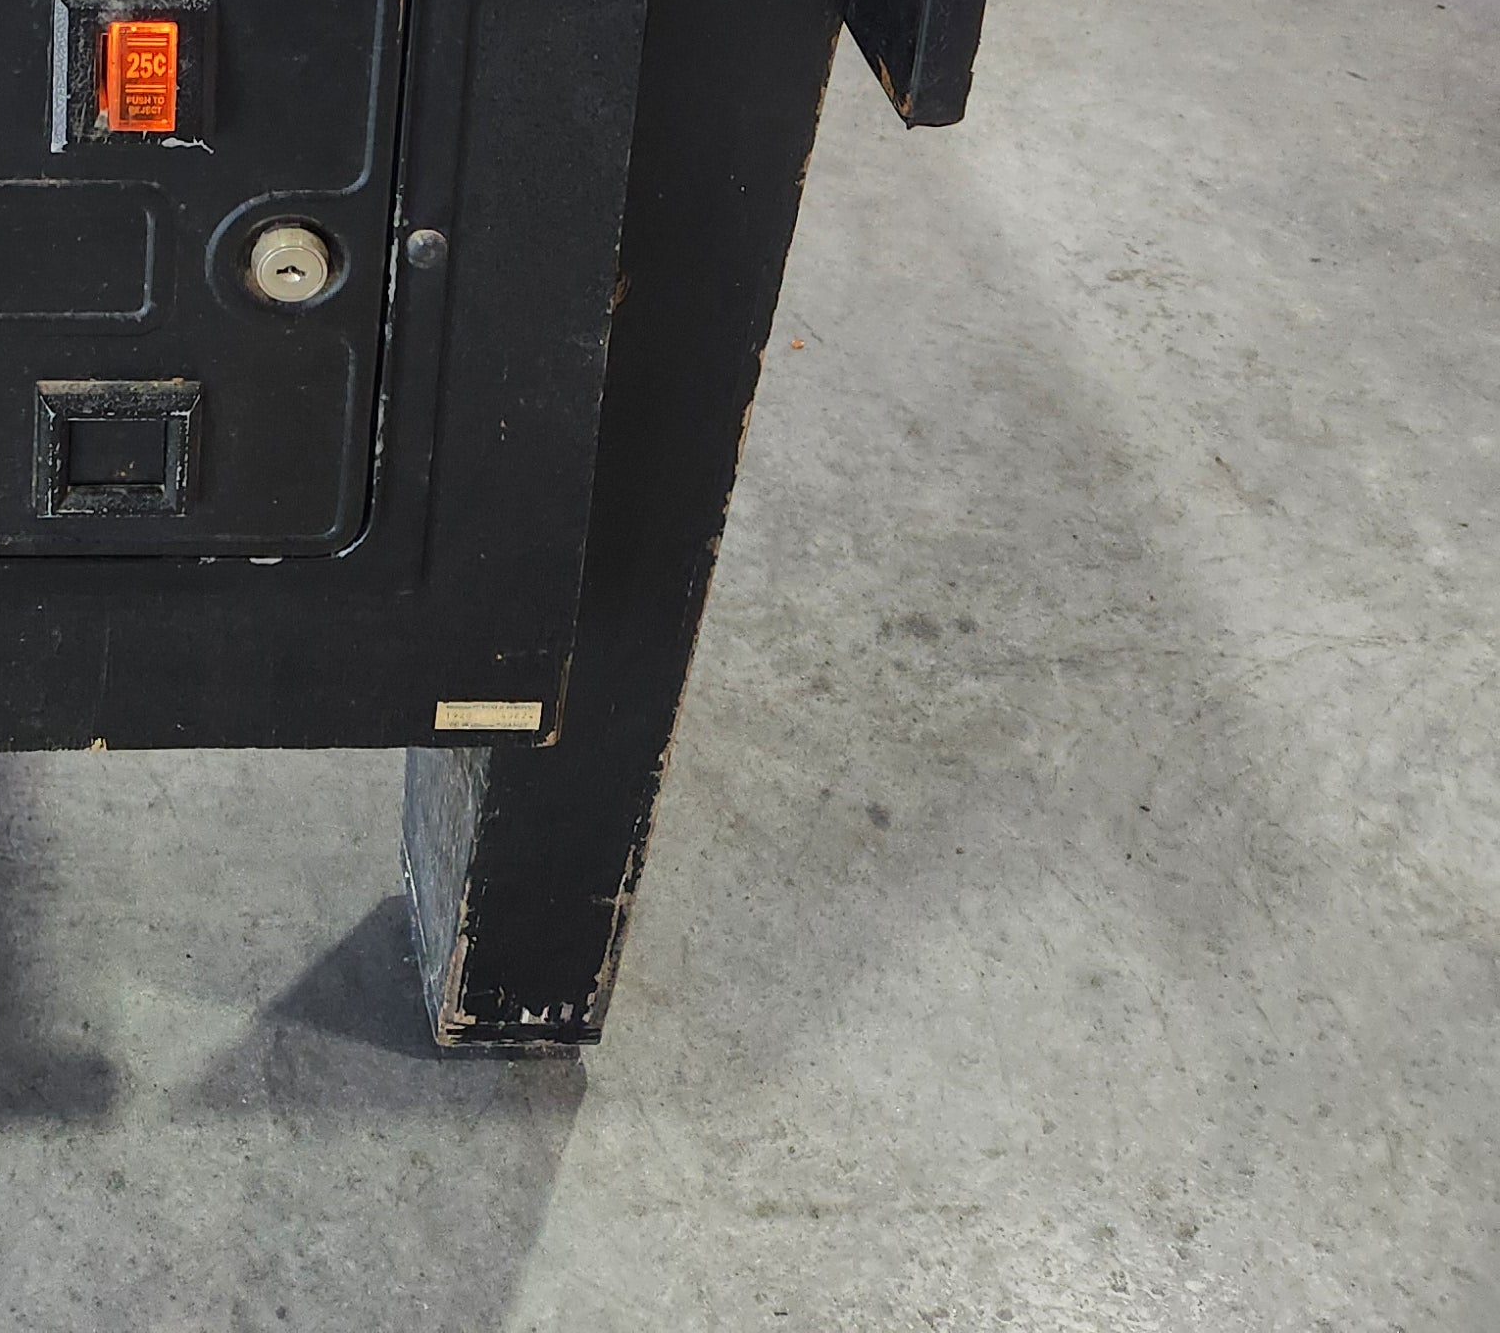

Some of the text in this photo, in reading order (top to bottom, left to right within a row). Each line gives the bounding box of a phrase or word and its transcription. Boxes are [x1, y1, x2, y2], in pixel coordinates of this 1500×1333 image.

[126, 52, 167, 79] 25¢
[126, 95, 165, 105] PUSH TO
[128, 106, 162, 115] REJECT
